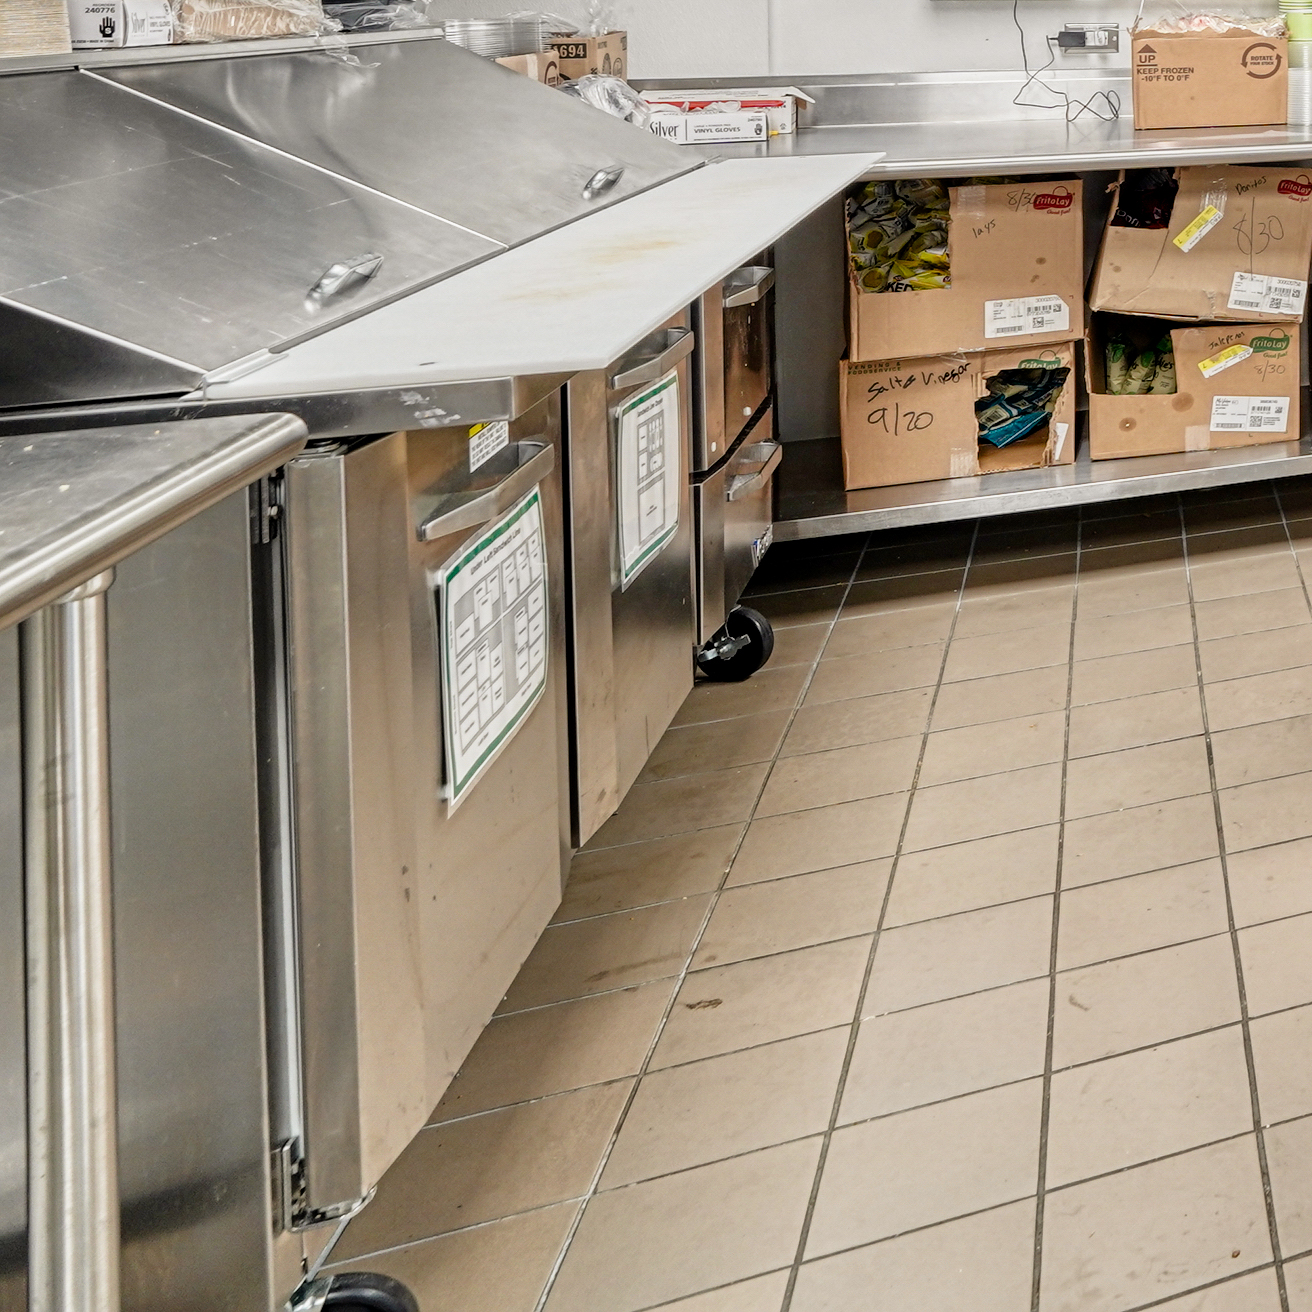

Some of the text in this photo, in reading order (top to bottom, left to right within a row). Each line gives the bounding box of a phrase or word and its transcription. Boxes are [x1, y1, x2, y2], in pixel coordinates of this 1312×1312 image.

[1139, 54, 1156, 64] UP
[1160, 67, 1195, 75] FROZEN
[716, 126, 741, 134] GLOVES
[1235, 175, 1267, 196] Doritos
[1233, 196, 1284, 280] 8/30
[848, 362, 891, 371] VENDING
[848, 367, 902, 375] FOODSERVICE
[921, 363, 971, 385] Vinegar
[1254, 360, 1286, 382] 8/30
[867, 402, 934, 436] 9/20
